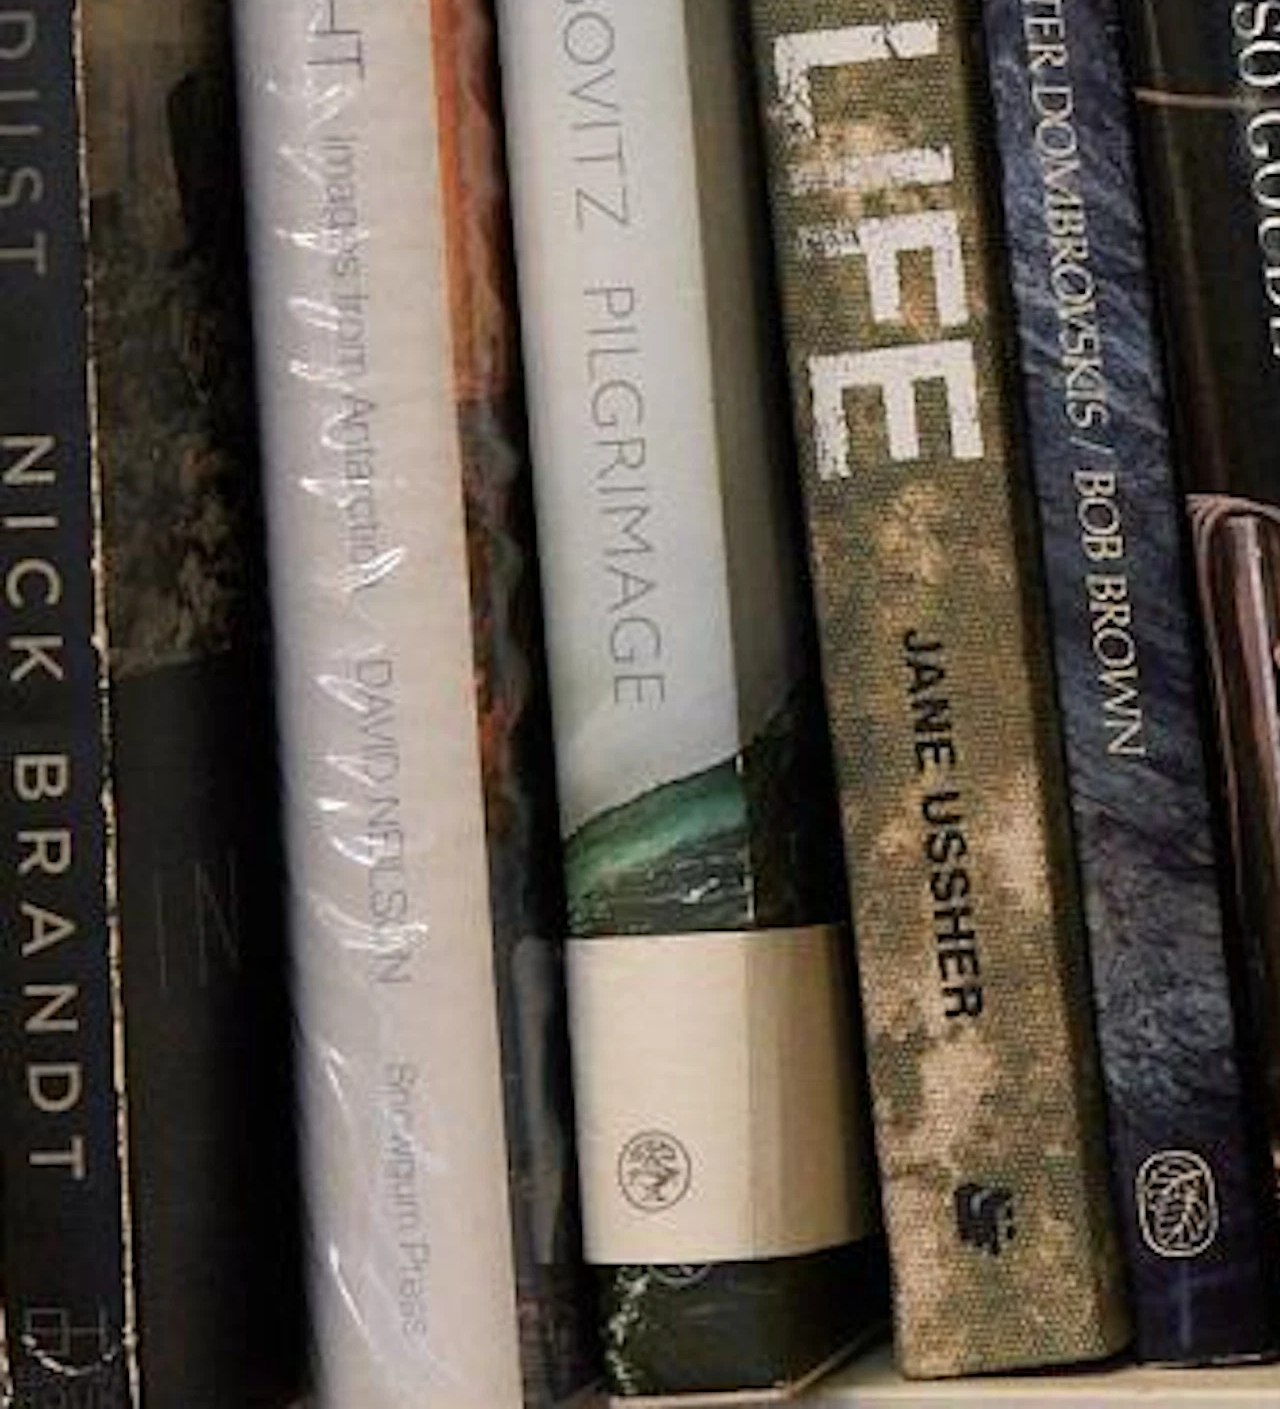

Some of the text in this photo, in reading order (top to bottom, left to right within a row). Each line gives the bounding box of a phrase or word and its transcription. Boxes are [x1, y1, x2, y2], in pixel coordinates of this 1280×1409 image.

[773, 21, 984, 480] LIFE
[1030, 83, 1108, 428] DOMBROVSKIS
[584, 284, 665, 709] PILGRIMAGE
[1073, 470, 1127, 560] BOB
[1086, 573, 1146, 757] BROWN
[1, 434, 85, 1180] NICK BRANDT
[902, 628, 984, 1021] JANE USSHER
